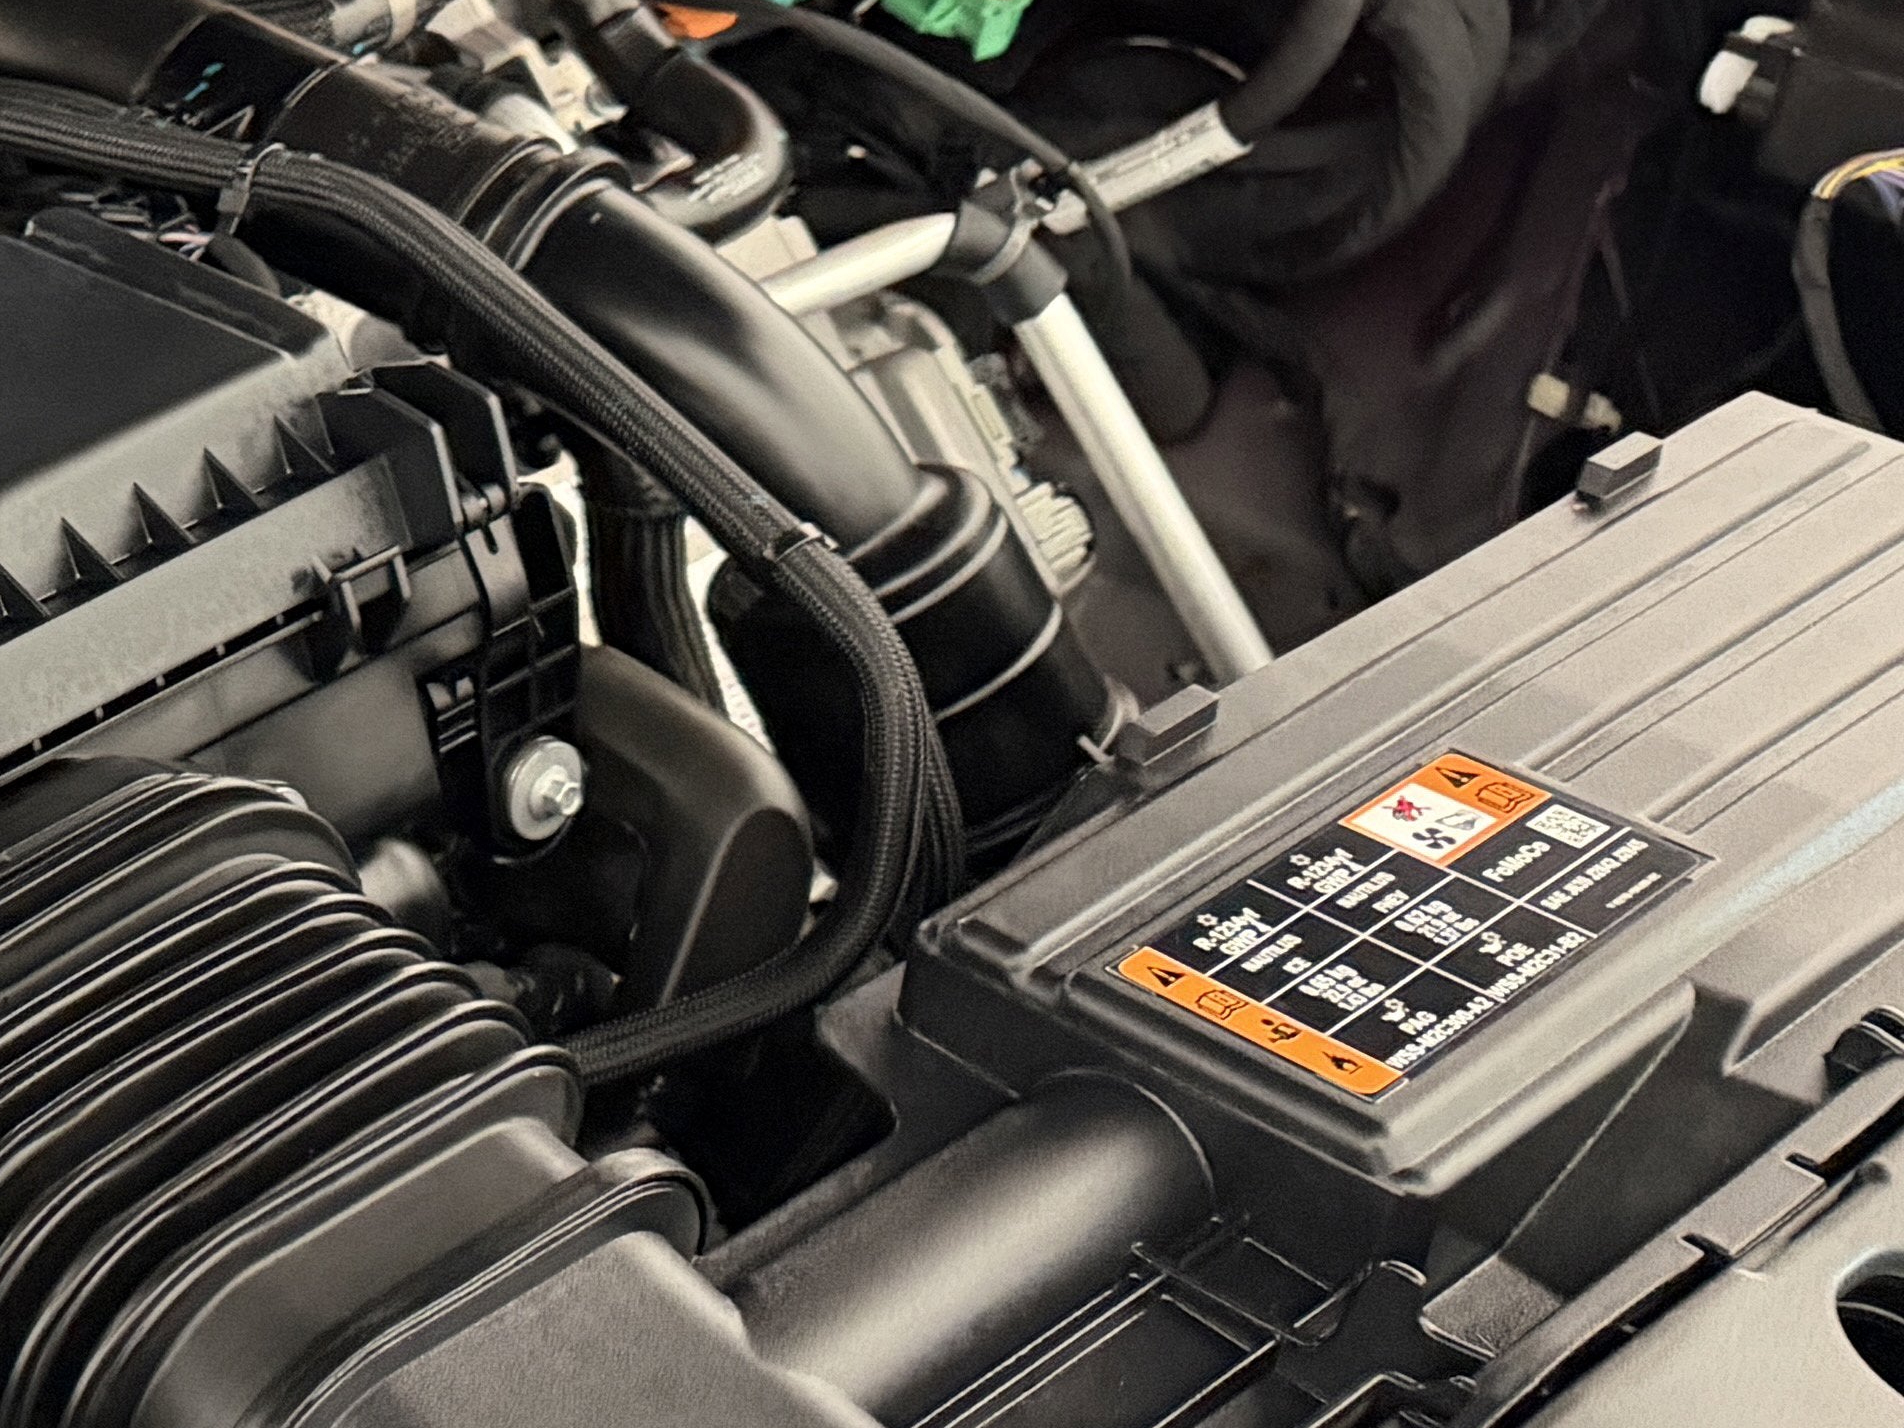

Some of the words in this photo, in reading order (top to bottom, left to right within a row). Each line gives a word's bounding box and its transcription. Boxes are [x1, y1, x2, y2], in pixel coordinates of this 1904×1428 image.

[1479, 838, 1555, 883] FoMoCo
[1494, 942, 1536, 967] POE
[1398, 1009, 1440, 1035] PAG
